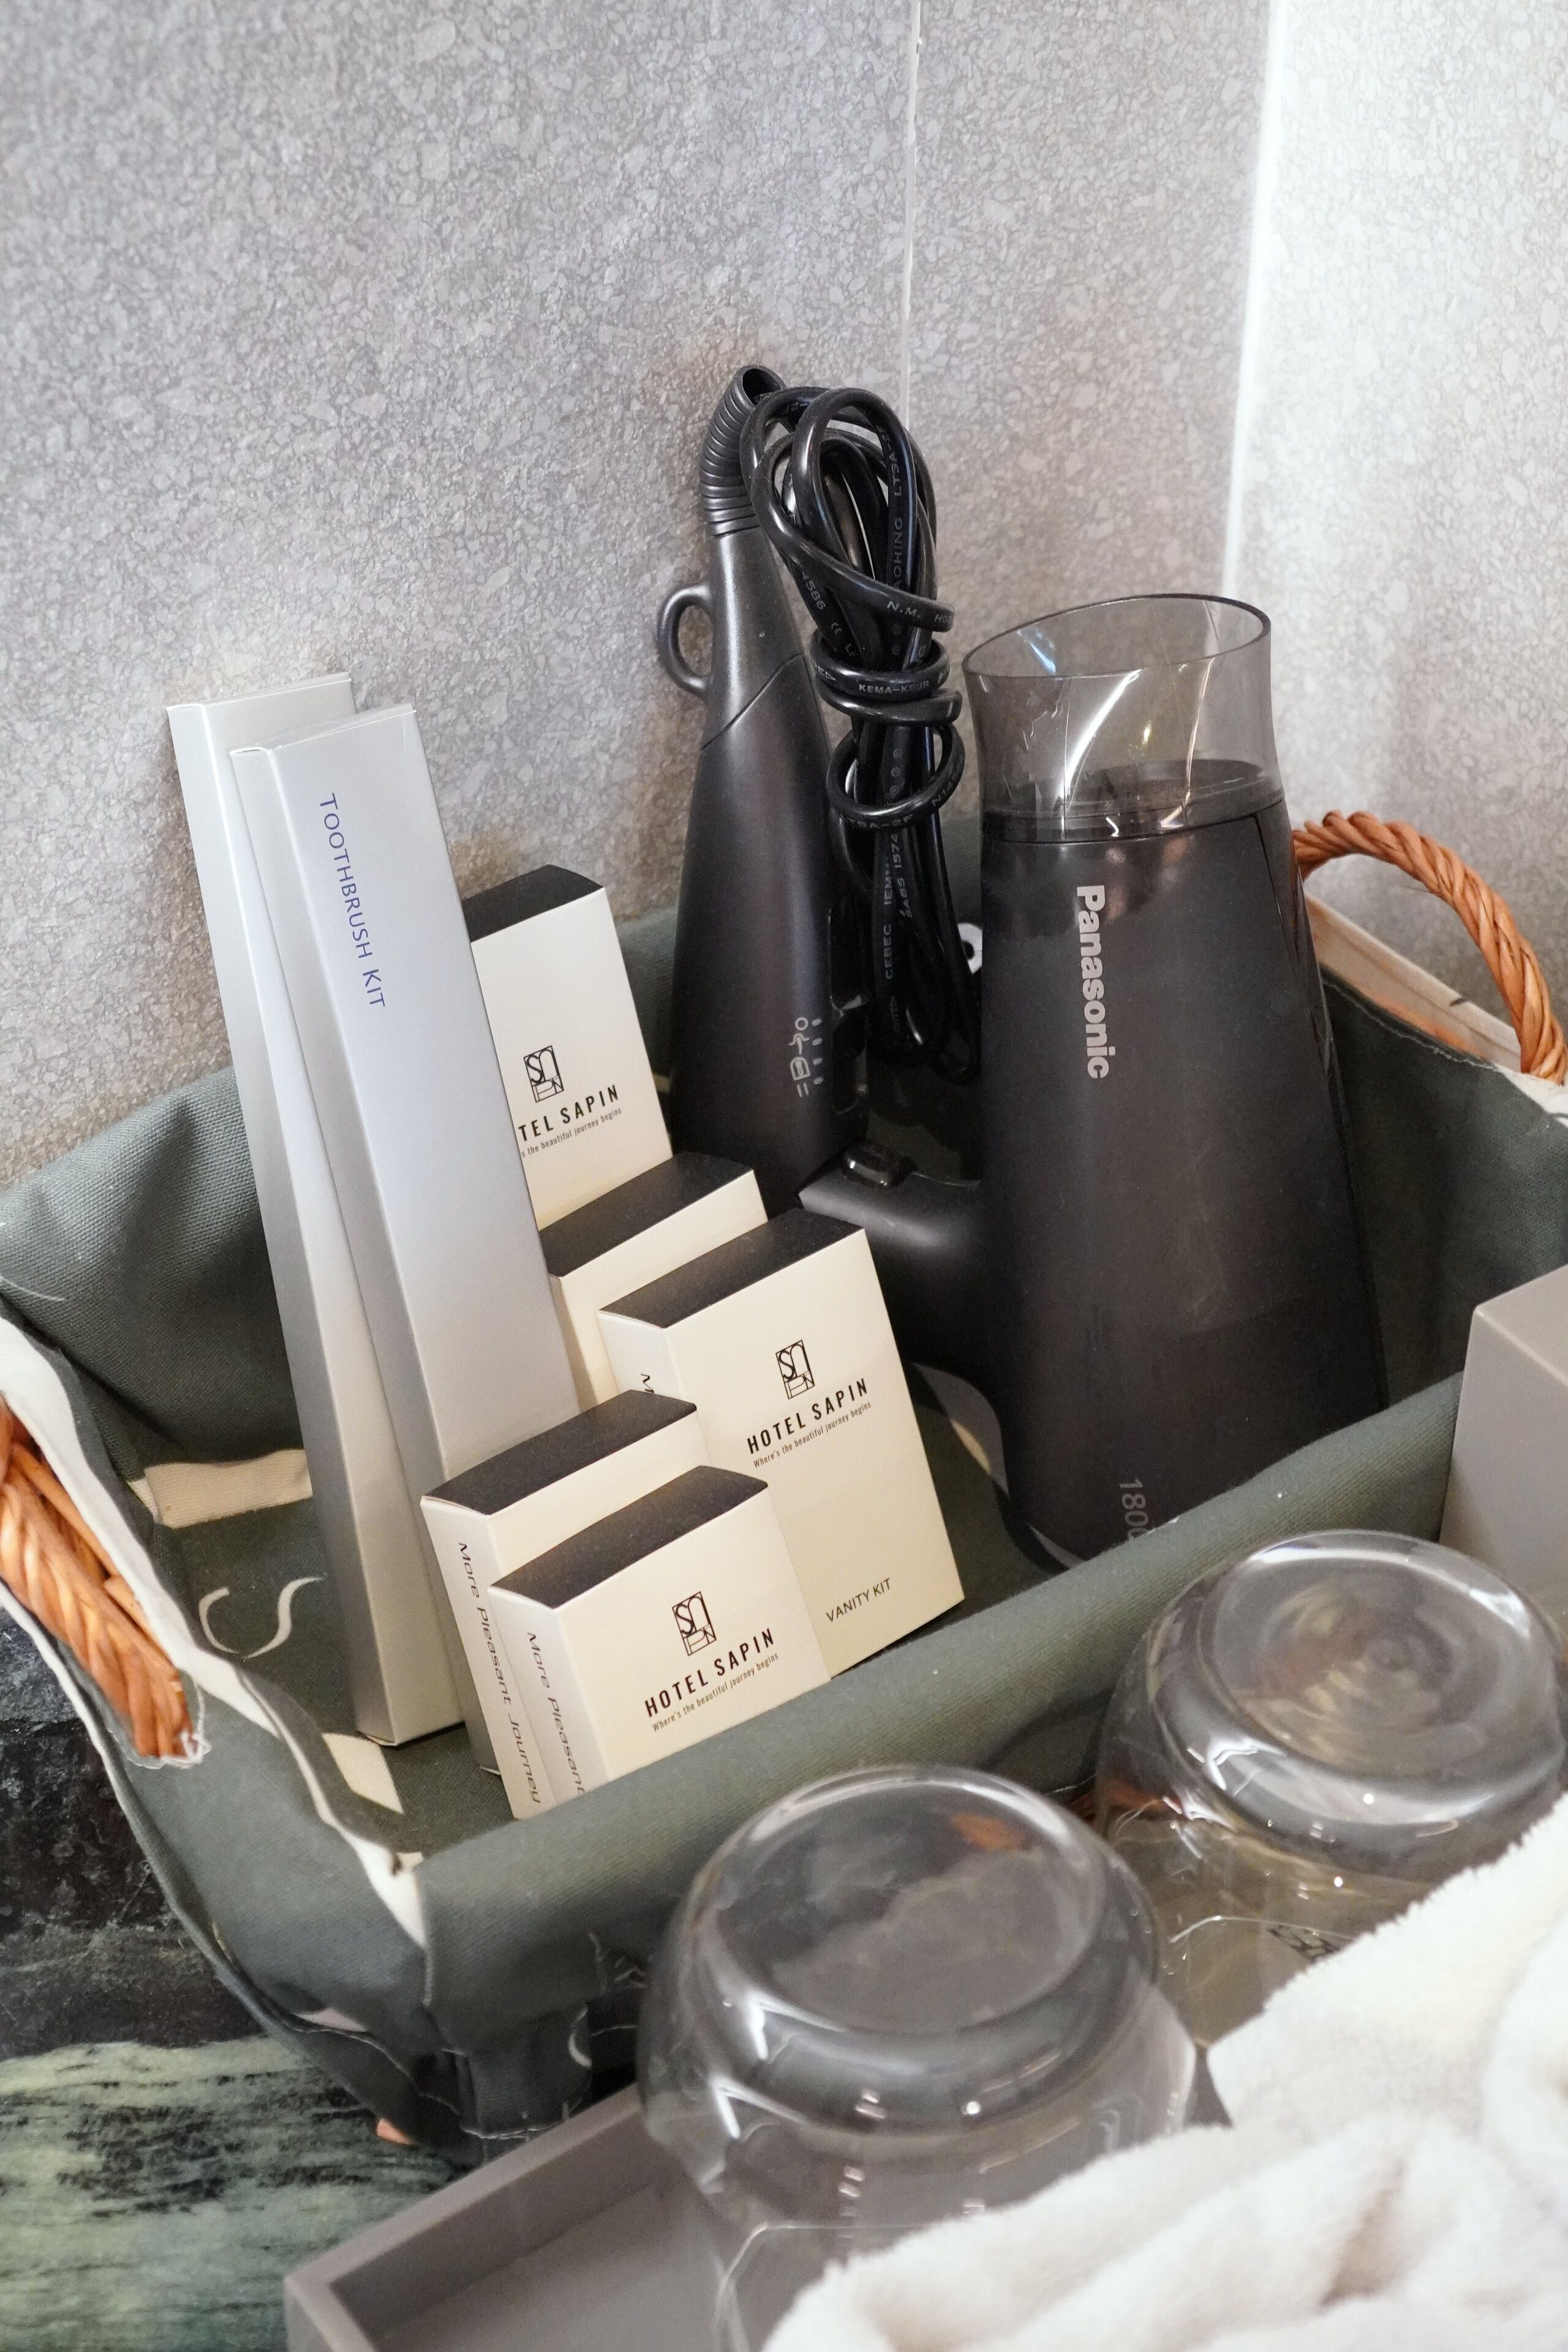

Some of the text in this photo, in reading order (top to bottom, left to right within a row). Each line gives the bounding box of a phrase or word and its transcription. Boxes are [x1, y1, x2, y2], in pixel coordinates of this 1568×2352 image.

[320, 793, 386, 1008] TOOTHBRUSH KIT
[1077, 885, 1115, 1079] Panasonic
[518, 1084, 619, 1142] TEL SAPIN
[527, 1145, 539, 1155] the
[541, 1130, 572, 1149] beautiful
[574, 1119, 598, 1137] journey
[601, 1108, 622, 1122] begins
[747, 1378, 867, 1455] HOTEL SAPIN
[753, 1401, 872, 1469] Where's the beautiful journey begins
[825, 1578, 892, 1623] VANITY KIT
[458, 1542, 541, 1804] More Pleasant Journey
[644, 1628, 774, 1717] HOTEL SAPIN
[652, 1653, 779, 1733] Where's the beautiful journey begins
[527, 1632, 586, 1795] More Pleasant
